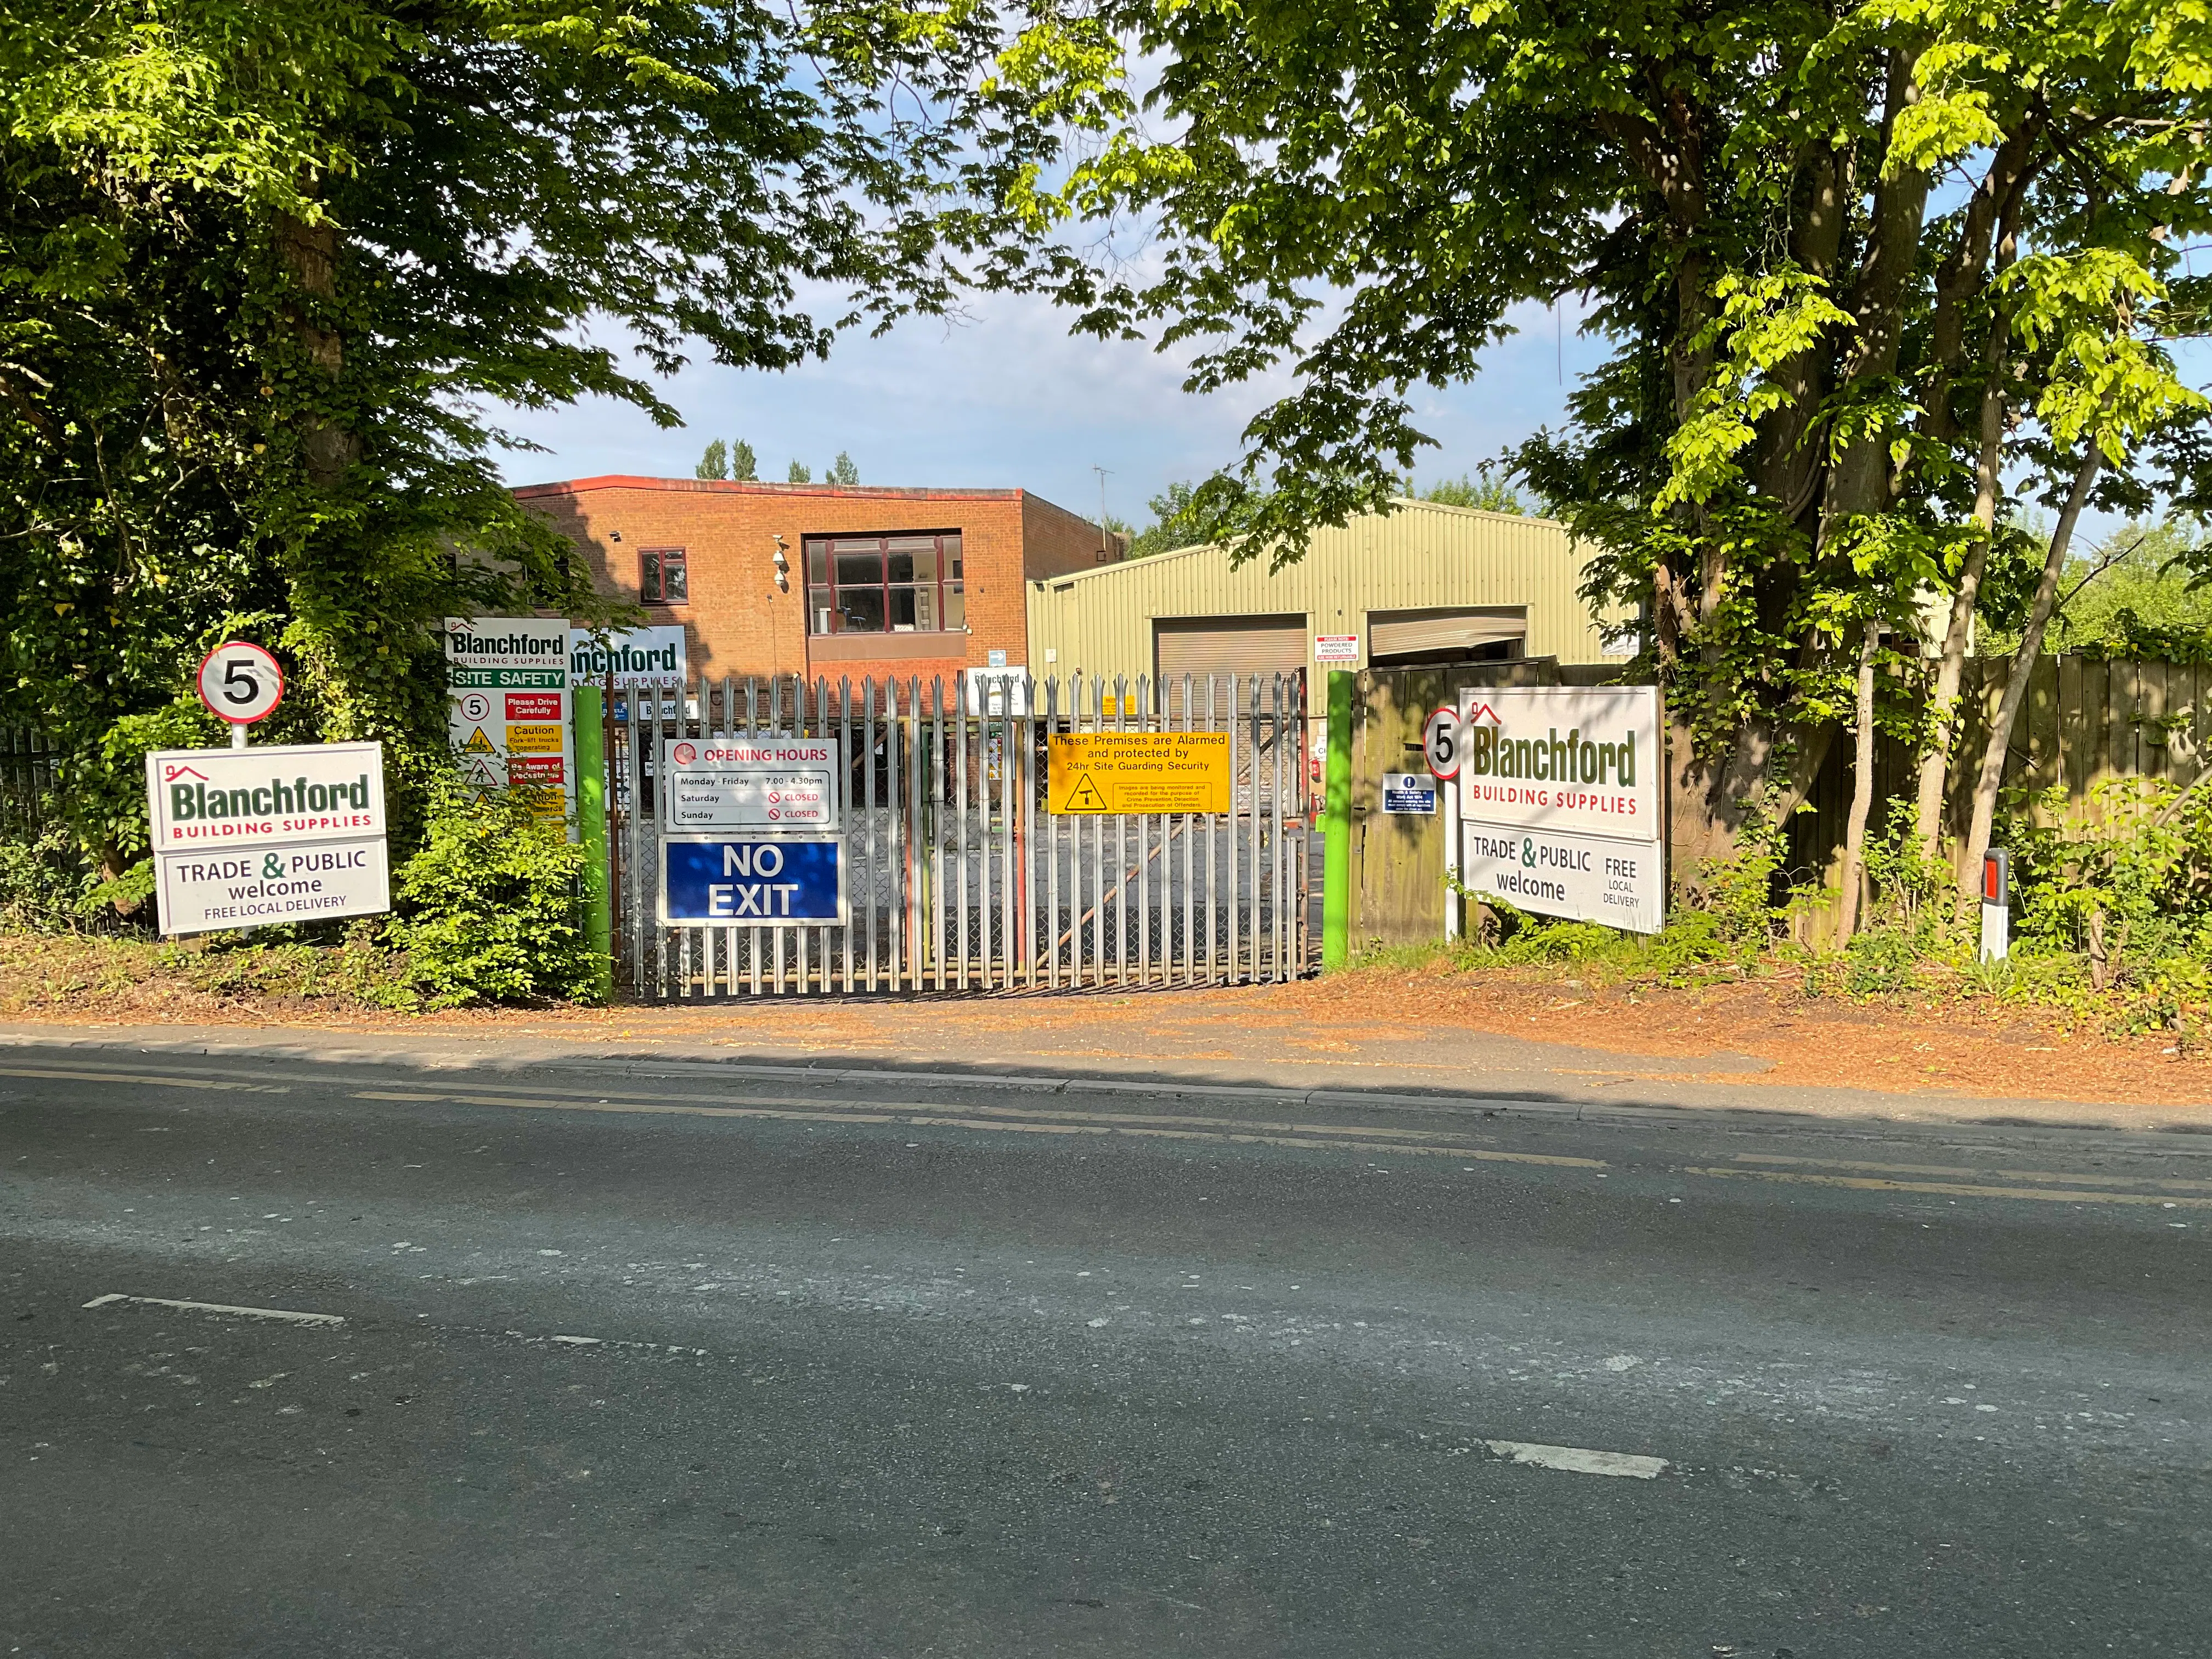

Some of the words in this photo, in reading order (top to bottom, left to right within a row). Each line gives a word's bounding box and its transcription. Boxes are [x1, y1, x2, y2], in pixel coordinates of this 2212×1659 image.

[453, 633, 563, 655] Blanchford
[223, 660, 259, 704] 5
[455, 672, 492, 685] SITE
[500, 672, 563, 685] SAFETY
[469, 700, 481, 715] 5
[516, 707, 551, 715] Carefully
[514, 726, 554, 735] Caution
[1053, 736, 1088, 746] These
[1094, 736, 1148, 745] Premises
[1177, 735, 1225, 744] Alarmed
[1088, 749, 1108, 758] and
[1114, 749, 1170, 759] protected
[1175, 748, 1189, 759] by
[1435, 723, 1453, 764] 5
[704, 749, 772, 761] OPENING
[776, 749, 827, 761] HOURS
[1474, 726, 1636, 787] Blanchford
[1067, 763, 1089, 771] 24hr
[1094, 762, 1114, 770] Site
[1118, 762, 1163, 771] Guarding
[1167, 761, 1210, 771] Security
[681, 777, 715, 786] Monday
[723, 777, 749, 786] Friday
[791, 777, 822, 786] 4.30pm
[170, 774, 370, 821] Blanchford
[681, 794, 719, 803] Saturday
[1474, 785, 1548, 806] BUILDING
[1556, 792, 1637, 815] SUPPLIES
[681, 811, 713, 820] Sunday
[173, 822, 273, 838] BUILDING
[283, 815, 371, 831] SUPPLIES
[724, 844, 784, 877] NO
[1474, 836, 1516, 860] TRADE
[1522, 837, 1537, 868] &
[1541, 845, 1590, 872] PUBLIC
[177, 860, 252, 883] TRADE
[262, 852, 286, 879] &
[292, 850, 366, 873] PUBLIC
[1606, 857, 1637, 878] FREE
[228, 879, 322, 900] welcome
[1497, 870, 1565, 901] welcome
[1609, 880, 1633, 893] LOCAL
[205, 907, 237, 919] FREE
[240, 902, 283, 916] LOCAL
[286, 895, 347, 912] DELIVERY
[709, 884, 798, 916] EXIT
[1603, 893, 1639, 909] DELIVERY
